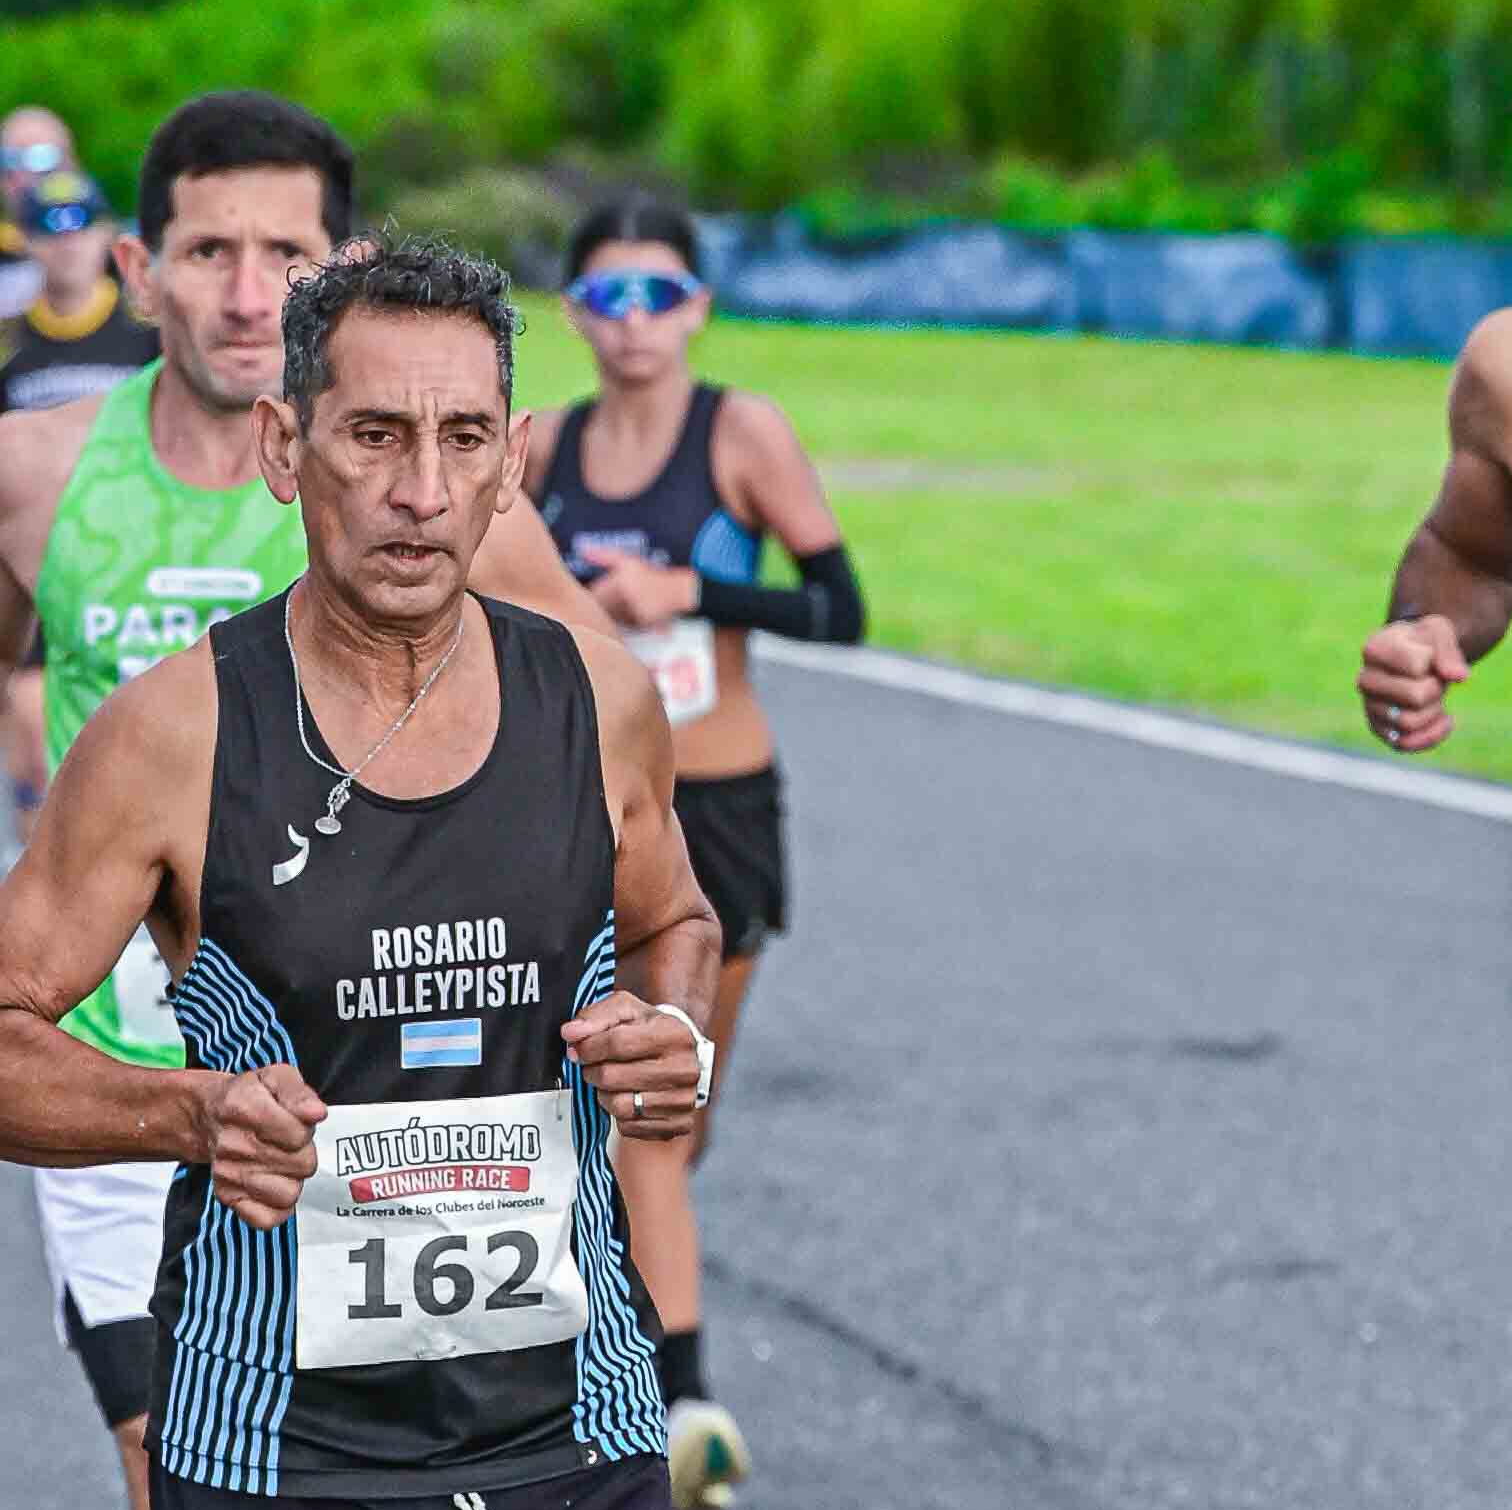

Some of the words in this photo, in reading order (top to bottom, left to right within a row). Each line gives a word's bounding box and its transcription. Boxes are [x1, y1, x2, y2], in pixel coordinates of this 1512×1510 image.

[371, 916, 507, 971] ROSARIO
[335, 961, 541, 1021] CALLEYPISTA
[335, 1116, 542, 1177] AUTÓDROMO
[336, 1206, 350, 1218] La
[352, 1206, 396, 1218] Carrera
[397, 1204, 413, 1217] de
[415, 1203, 432, 1216] los
[435, 1200, 474, 1213] Clubes
[477, 1198, 495, 1211] del
[497, 1196, 545, 1210] Noroeste
[370, 1168, 456, 1200] RUNNING
[461, 1168, 512, 1190] RACE
[347, 1229, 544, 1320] 162
